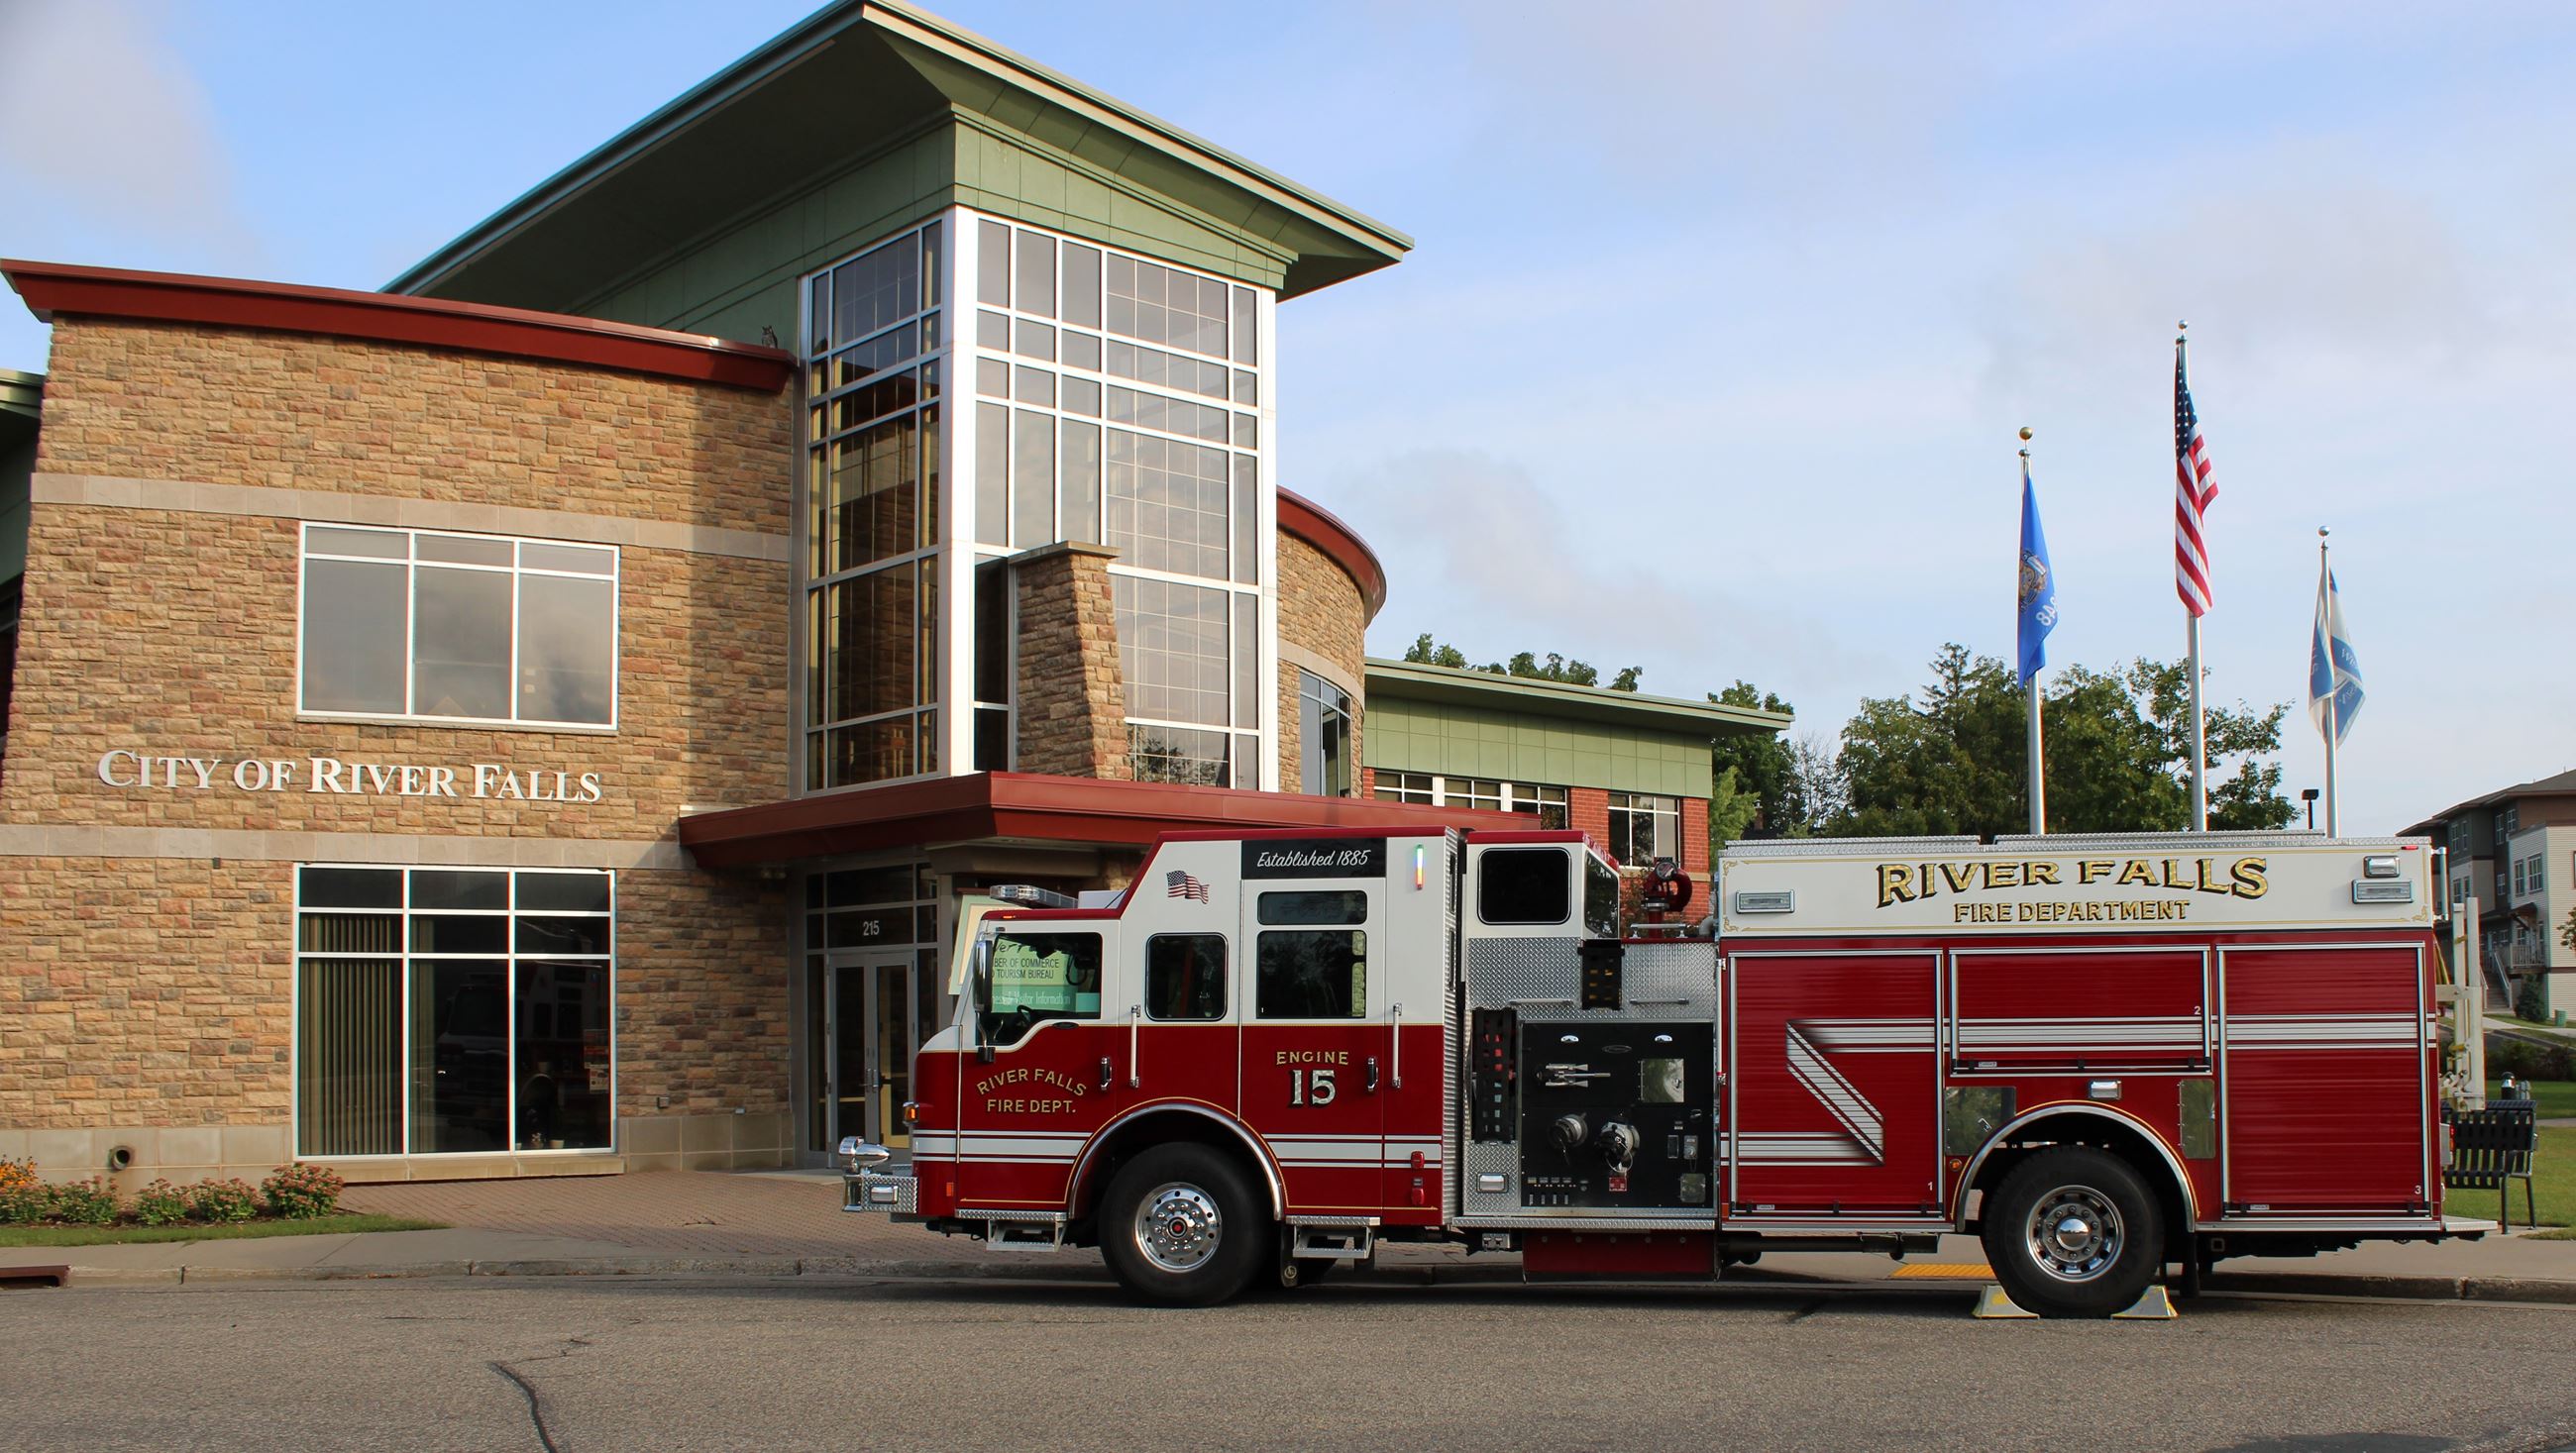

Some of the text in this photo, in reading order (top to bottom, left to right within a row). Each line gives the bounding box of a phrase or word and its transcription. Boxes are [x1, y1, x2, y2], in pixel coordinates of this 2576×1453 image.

[98, 749, 600, 802] CITY OF RIVER FALLS
[1257, 849, 1371, 867] Established 1885
[1876, 857, 2269, 908] RIVER FALLS
[1953, 900, 2190, 923] FIRE DEPARTMENT
[863, 920, 880, 936] 215
[1010, 957, 1019, 968] OF
[1020, 958, 1059, 968] COMMERCE
[997, 969, 1054, 980] TOURISM BUREAU
[2194, 1005, 2201, 1015] 2
[1276, 1051, 1348, 1066] ENGINE
[976, 1069, 1087, 1096] RIVER FALLS
[1290, 1069, 1336, 1105] 15
[987, 1098, 1076, 1113] FIRE DEPT.
[1927, 1181, 1933, 1192] 1
[2414, 1185, 2421, 1194] 3
